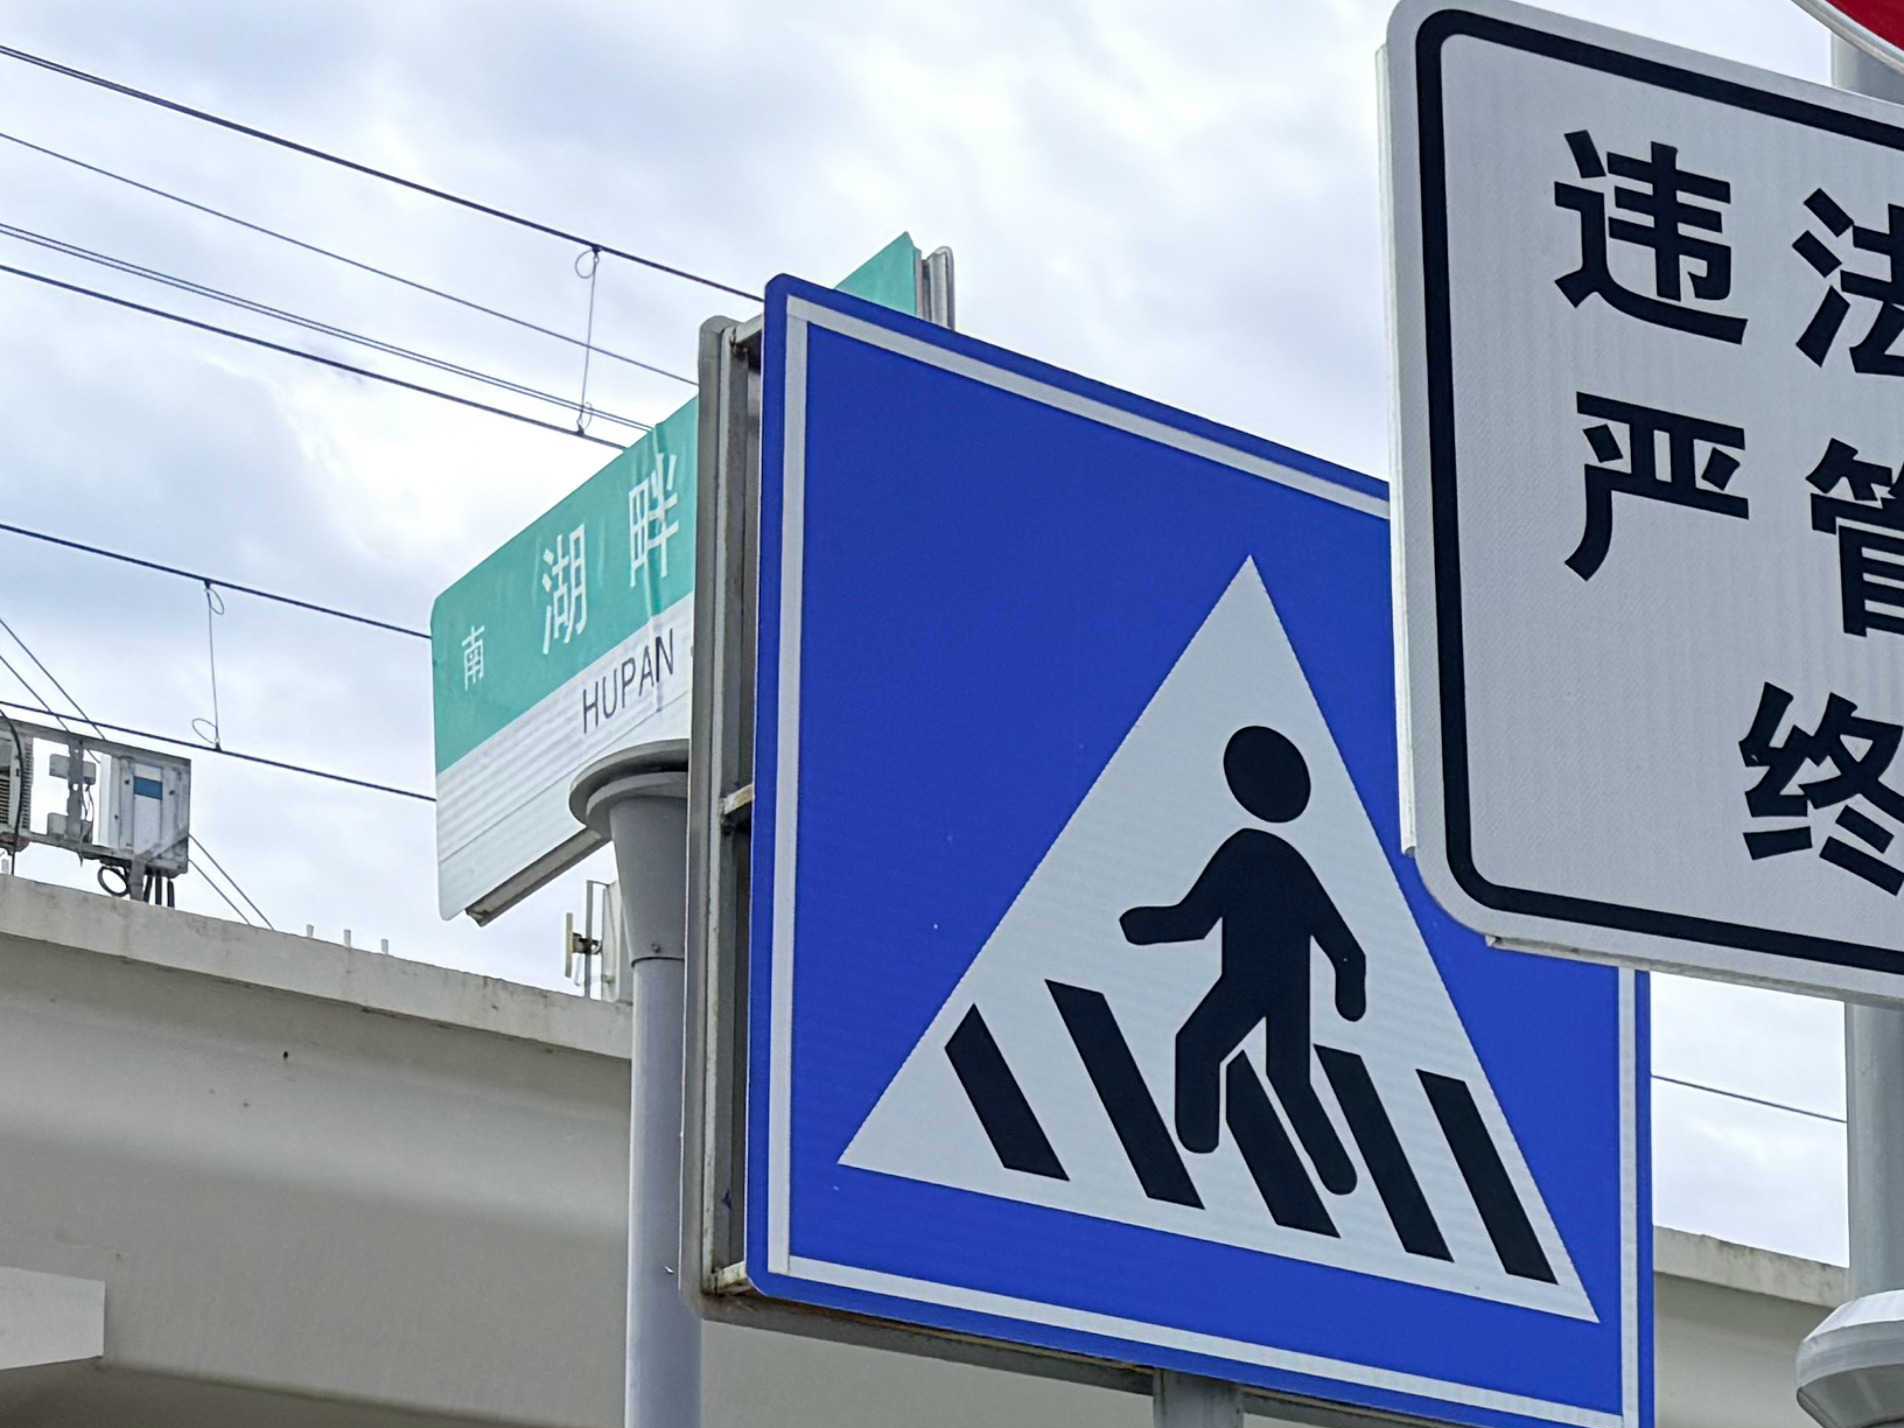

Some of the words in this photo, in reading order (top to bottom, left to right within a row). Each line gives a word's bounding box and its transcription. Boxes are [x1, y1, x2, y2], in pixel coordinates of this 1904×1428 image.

[542, 453, 679, 655] 湖畔
[461, 625, 485, 691] 南
[582, 628, 673, 734] HUPAN
